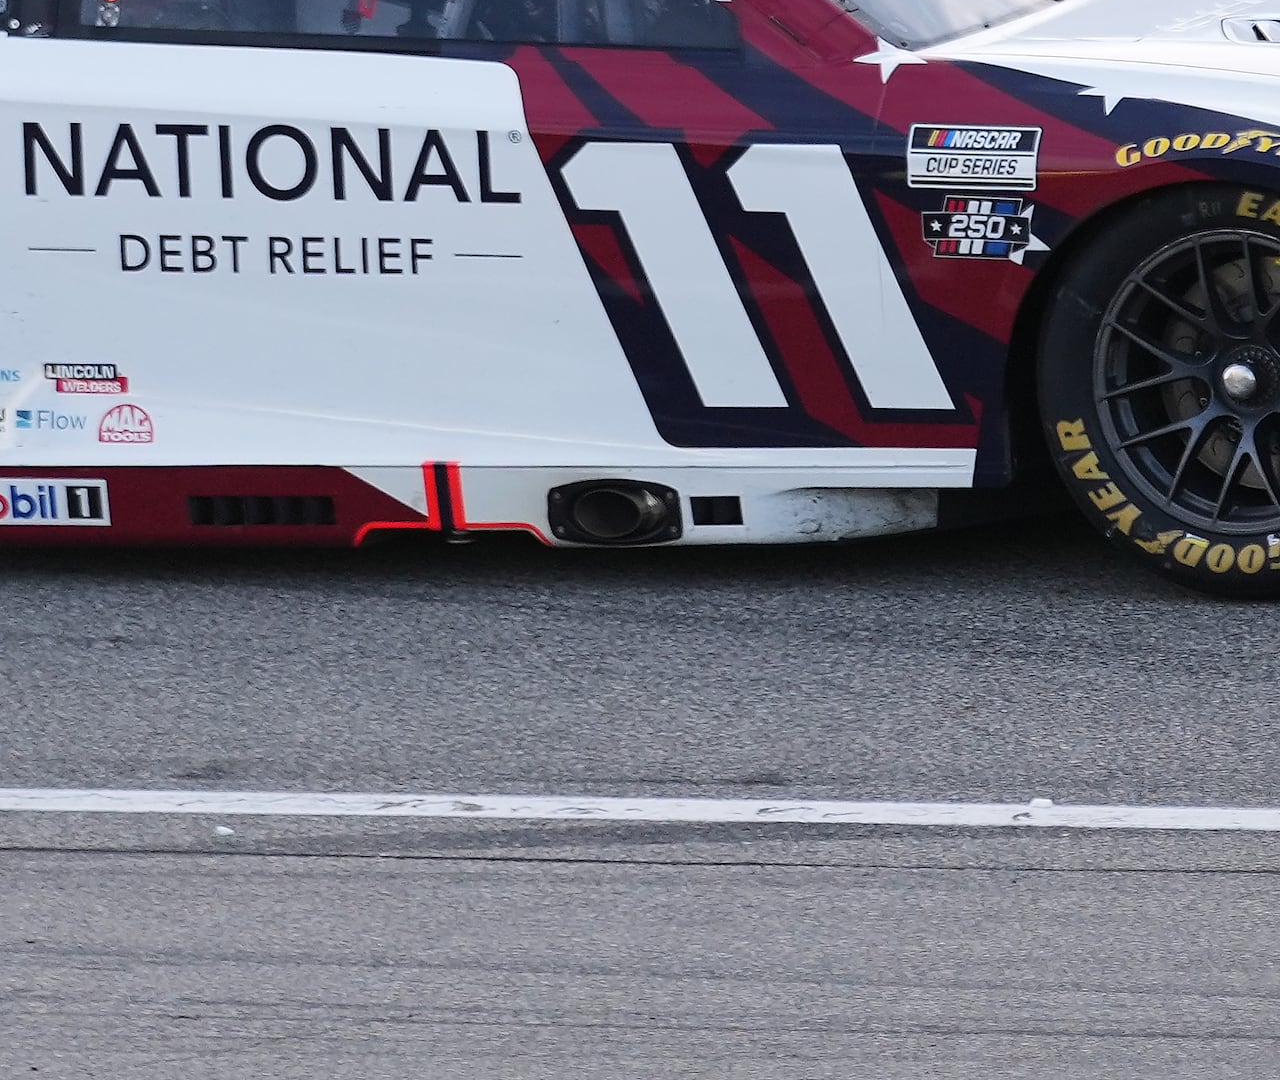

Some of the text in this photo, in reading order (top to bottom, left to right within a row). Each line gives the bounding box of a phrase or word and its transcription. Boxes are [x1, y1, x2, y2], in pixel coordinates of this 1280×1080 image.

[950, 130, 1022, 149] NASCAR
[926, 157, 1018, 175] CUP SERIES
[948, 215, 1006, 239] 250
[120, 234, 434, 275] DEBT RELIEF
[560, 141, 956, 410] 11
[45, 364, 115, 379] LINCOLN
[62, 380, 122, 393] WELDERS
[37, 411, 88, 430] Flow
[105, 406, 148, 432] MAC
[102, 430, 151, 442] TOOLS
[73, 486, 93, 519] 1
